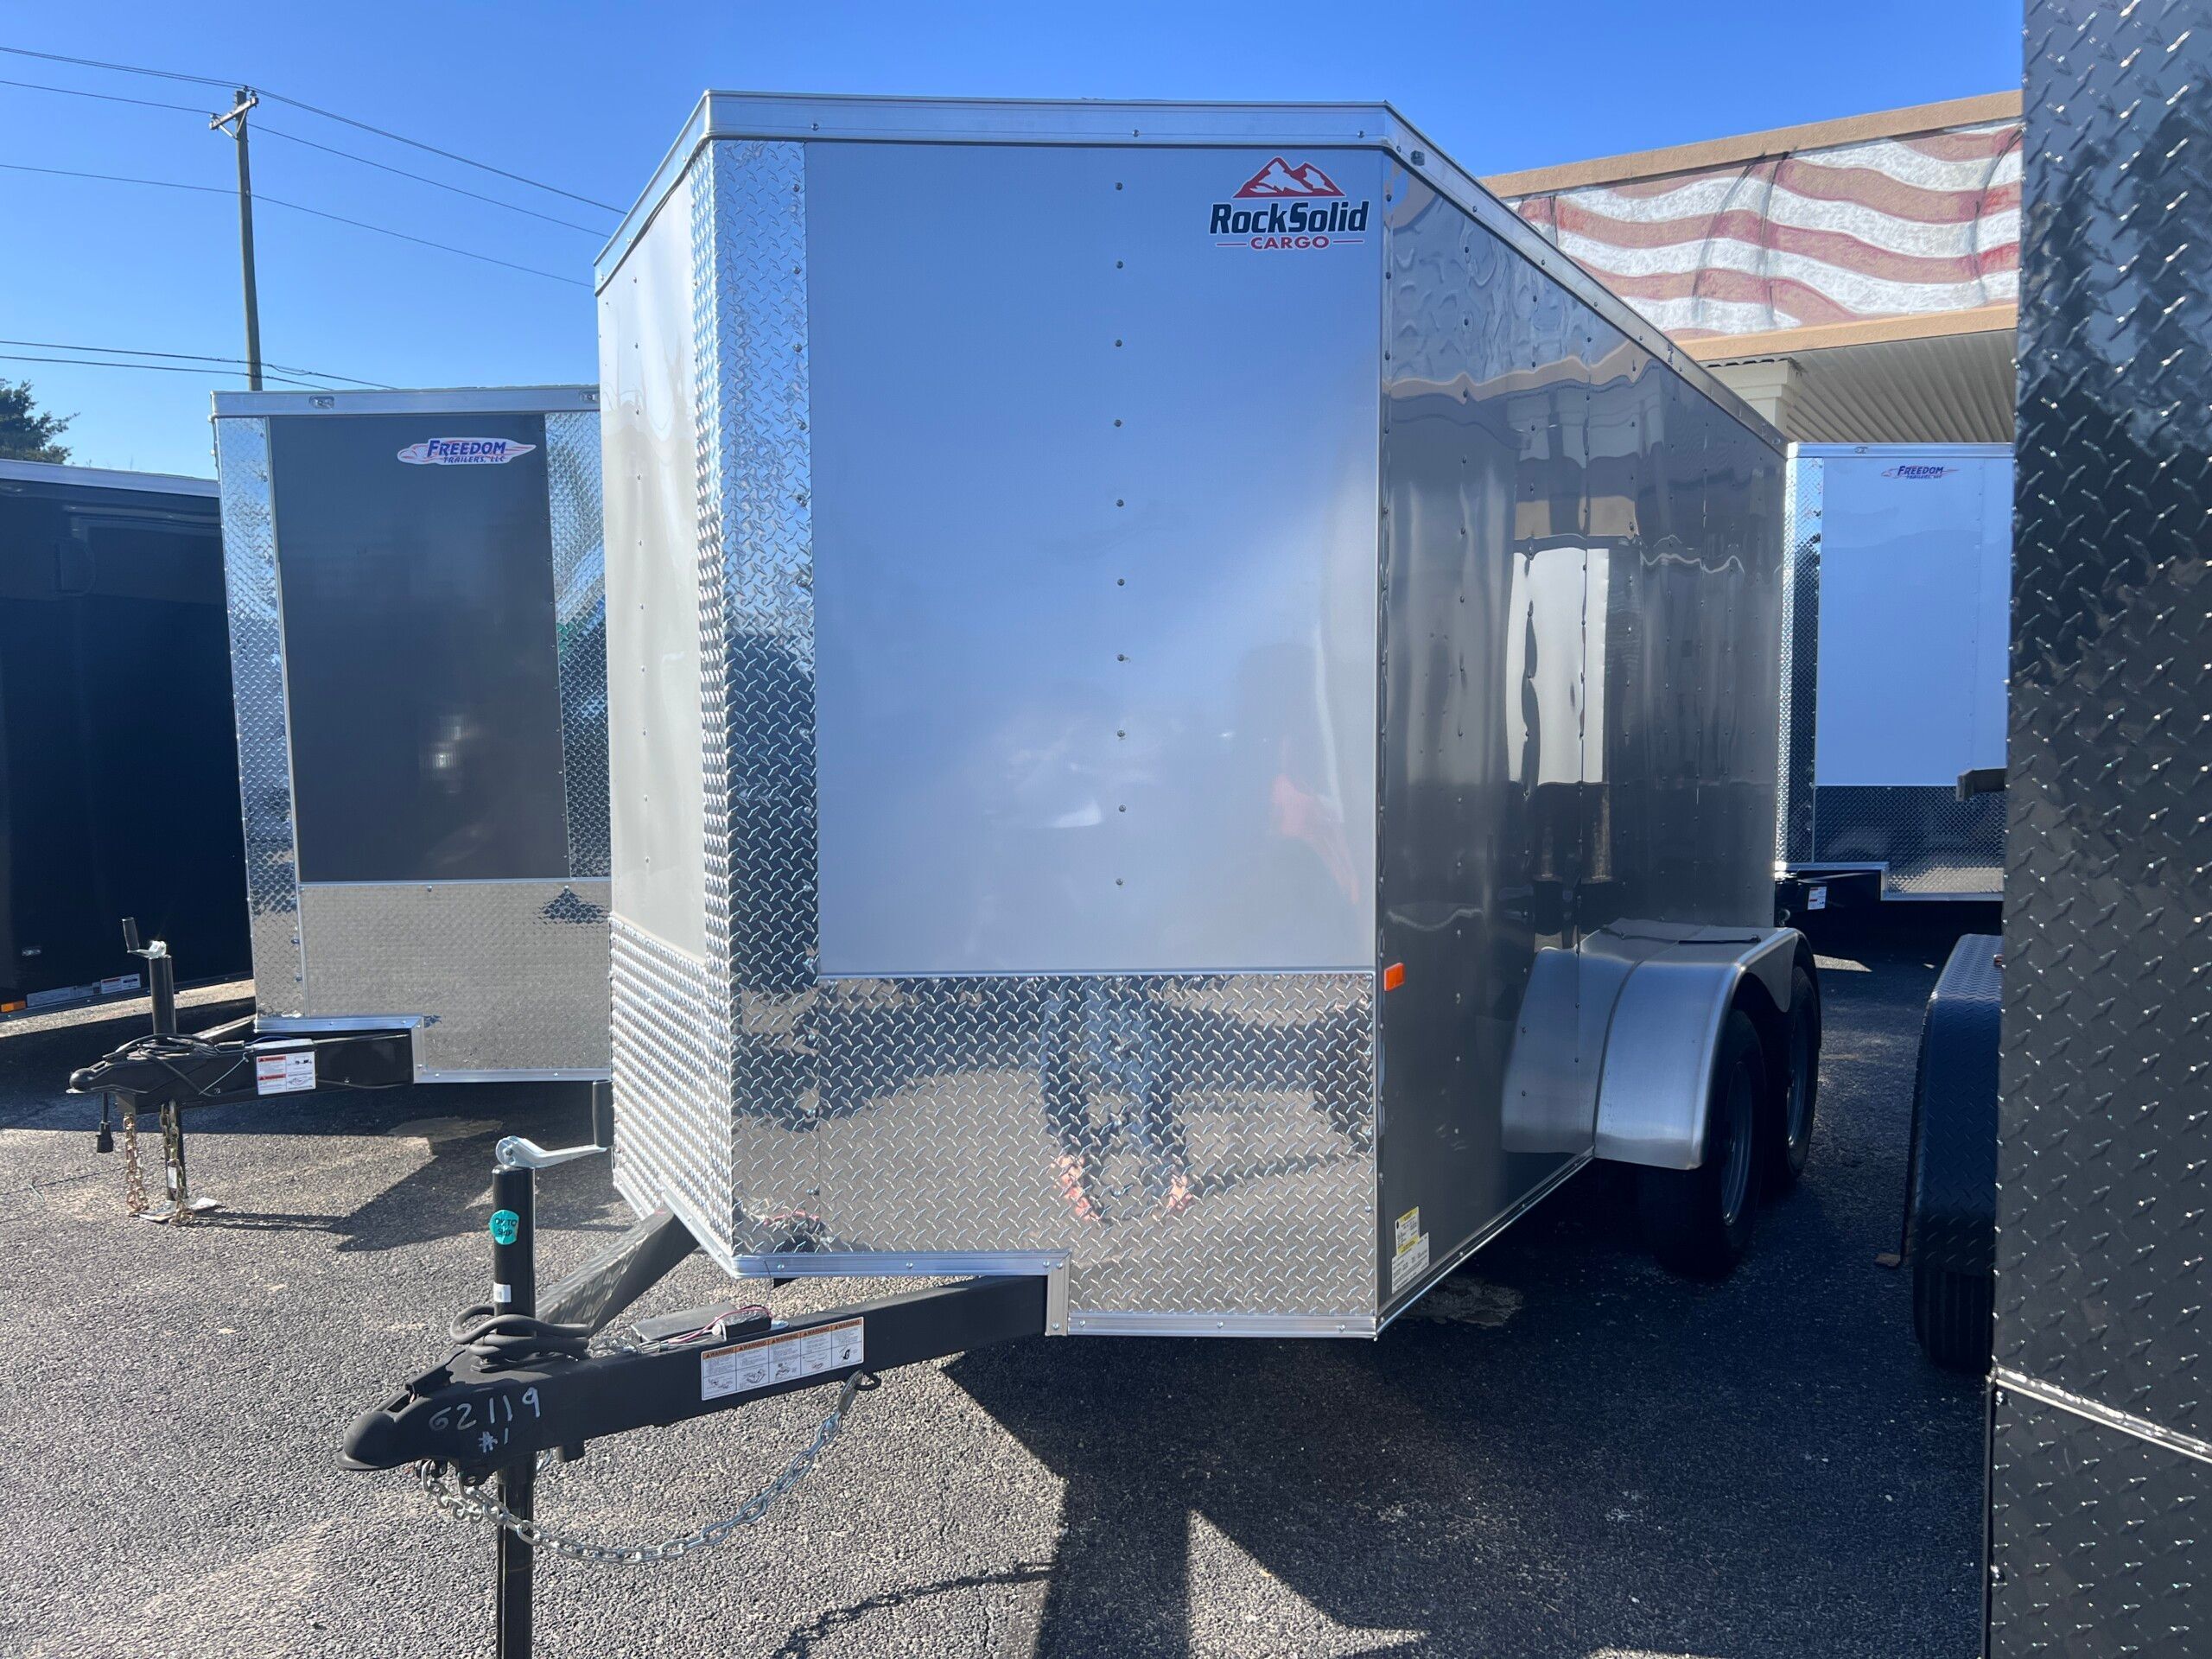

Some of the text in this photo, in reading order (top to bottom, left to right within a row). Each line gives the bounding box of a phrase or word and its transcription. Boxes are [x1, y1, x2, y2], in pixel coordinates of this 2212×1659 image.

[1210, 200, 1370, 234] RockSolid
[1250, 236, 1330, 250] CARGO
[427, 440, 506, 458] FREEDOM
[1897, 466, 1943, 476] FREEDOM
[478, 1427, 513, 1453] #1
